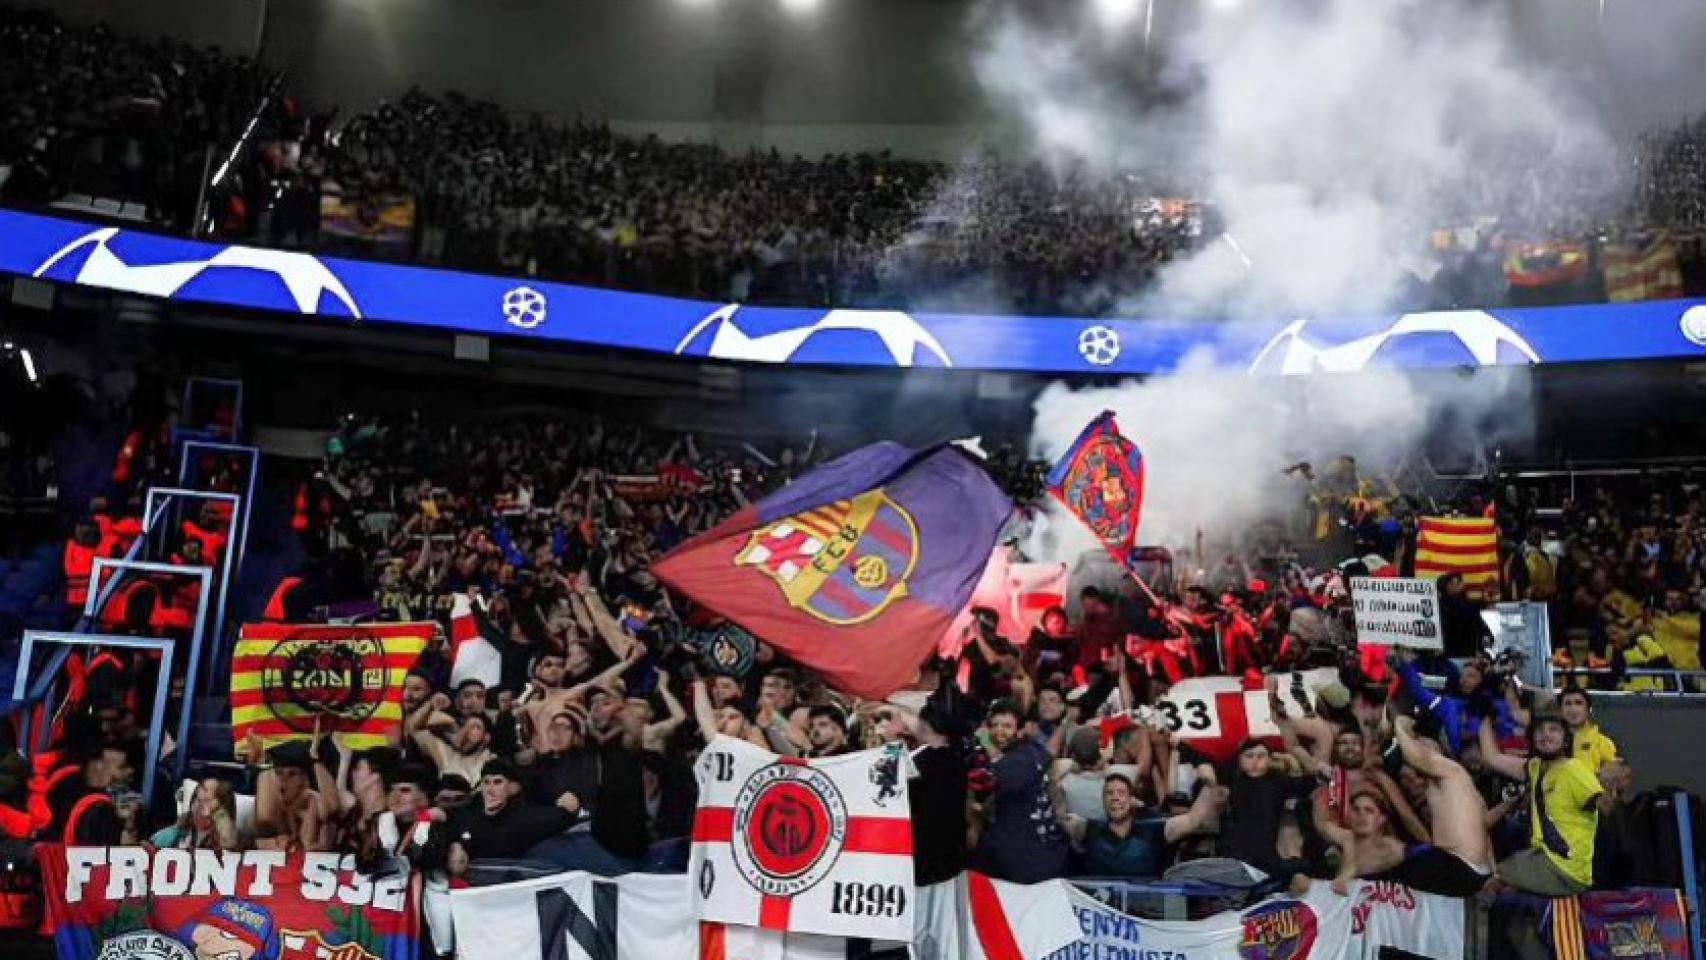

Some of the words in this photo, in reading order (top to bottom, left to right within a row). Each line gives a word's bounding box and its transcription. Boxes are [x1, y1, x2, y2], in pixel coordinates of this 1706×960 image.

[813, 523, 859, 573] FCB
[64, 846, 286, 904] FRONT
[831, 881, 906, 918] 1899
[535, 879, 619, 960] N
